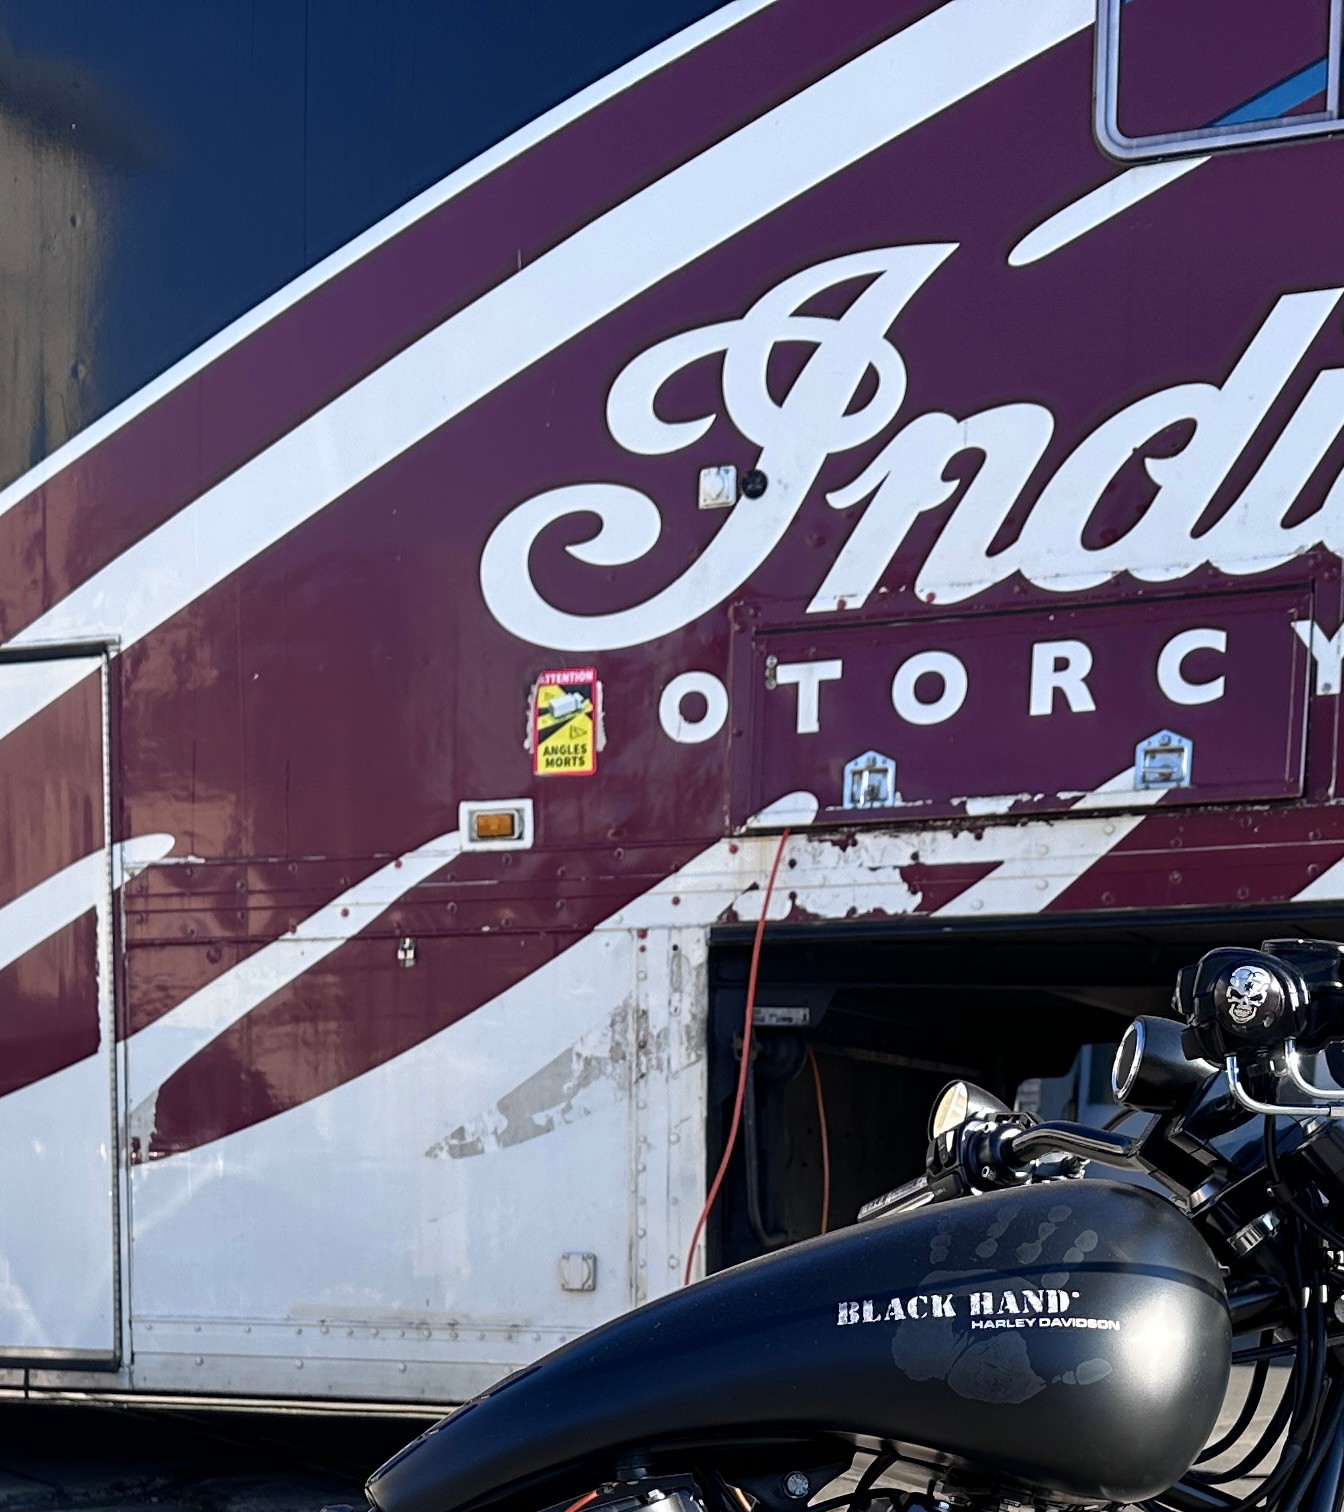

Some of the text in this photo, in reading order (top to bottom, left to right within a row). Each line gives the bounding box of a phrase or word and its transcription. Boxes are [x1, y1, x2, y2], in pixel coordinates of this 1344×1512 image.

[543, 743, 587, 757] ANGLES
[545, 756, 586, 769] MORTS
[837, 1289, 1071, 1326] BLACK HAND
[971, 1317, 1121, 1331] HARLEY DAVIDSON
